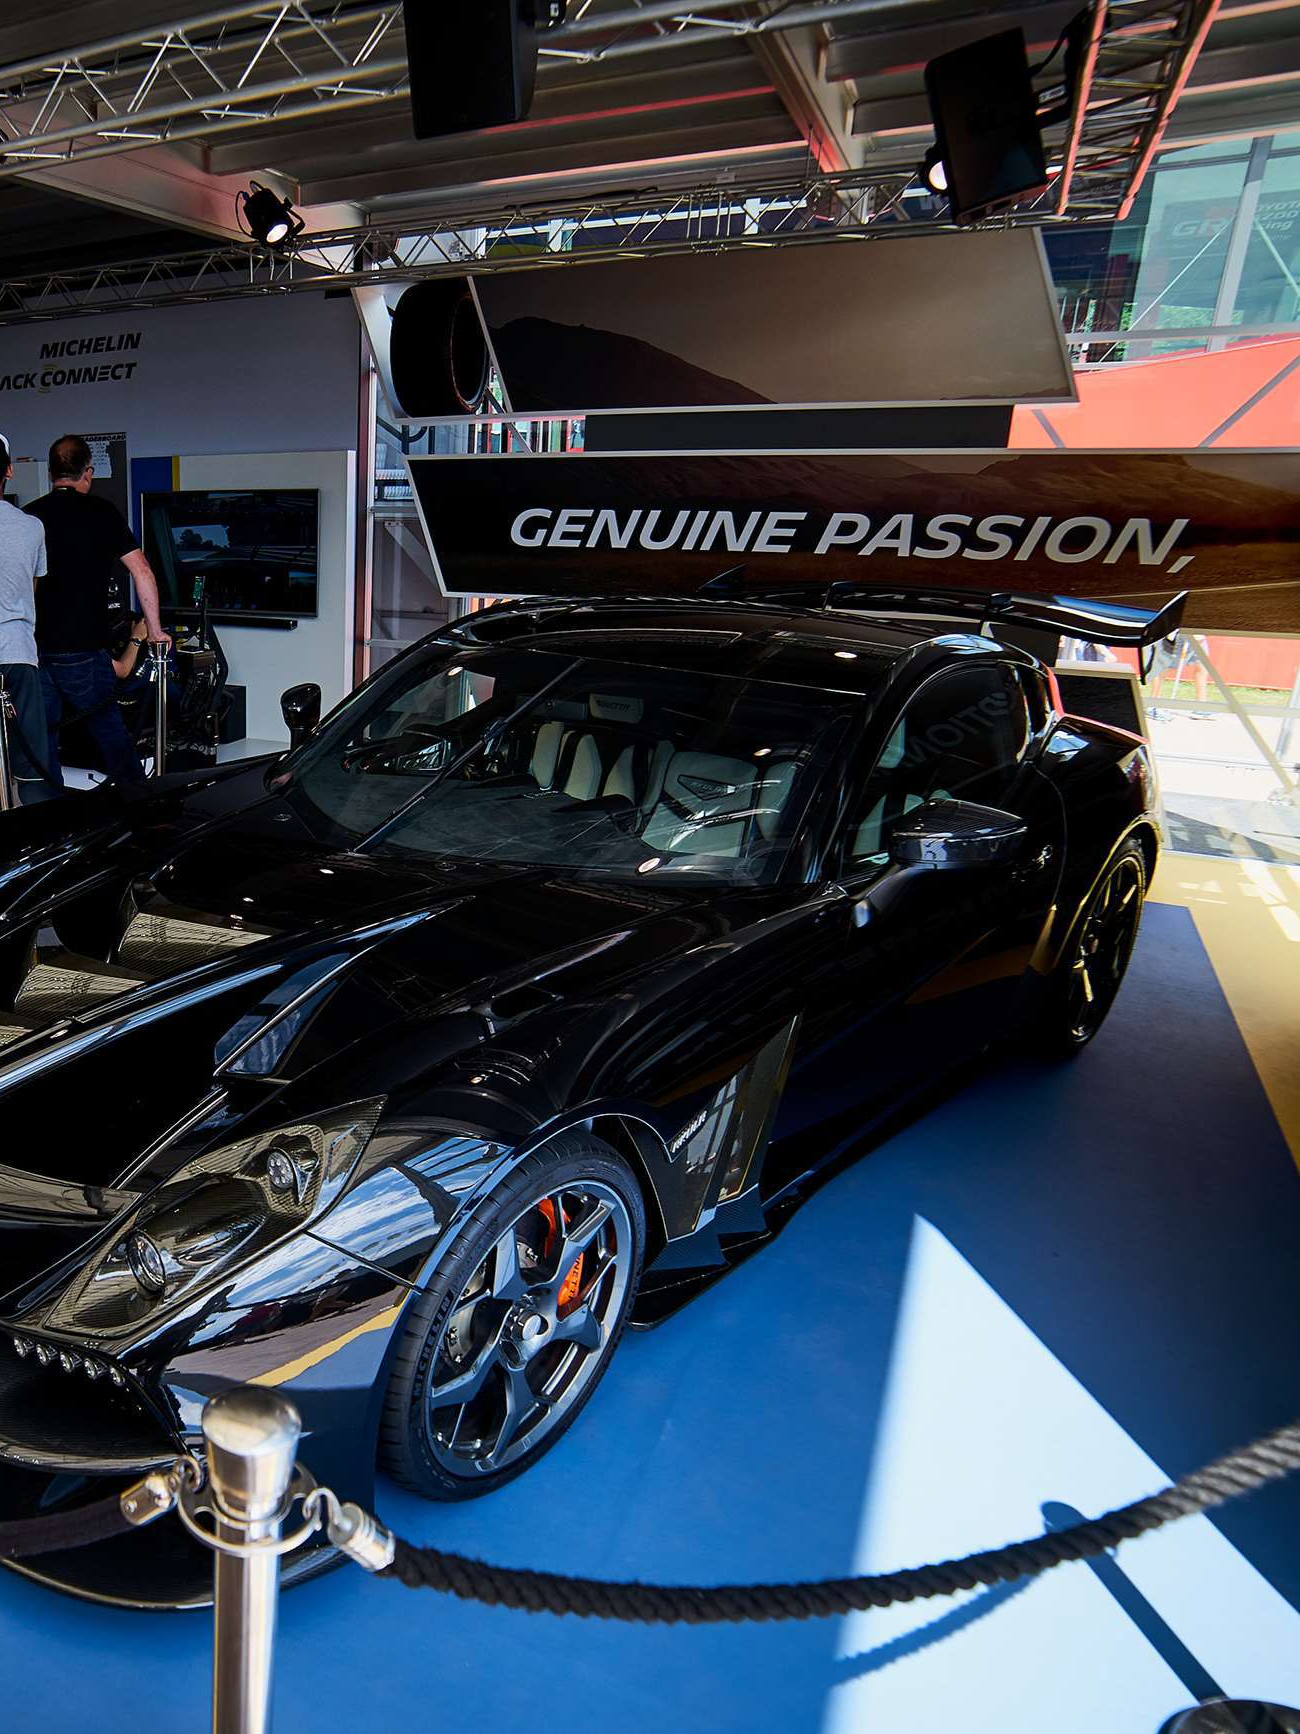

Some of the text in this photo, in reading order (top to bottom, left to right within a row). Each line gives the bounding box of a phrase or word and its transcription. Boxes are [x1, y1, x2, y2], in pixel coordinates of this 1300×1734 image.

[39, 332, 142, 360] MICHELIN
[40, 362, 138, 388] CONNECT
[510, 507, 1196, 575] GENUINE PASSION,
[411, 1295, 452, 1397] MICHELIN
